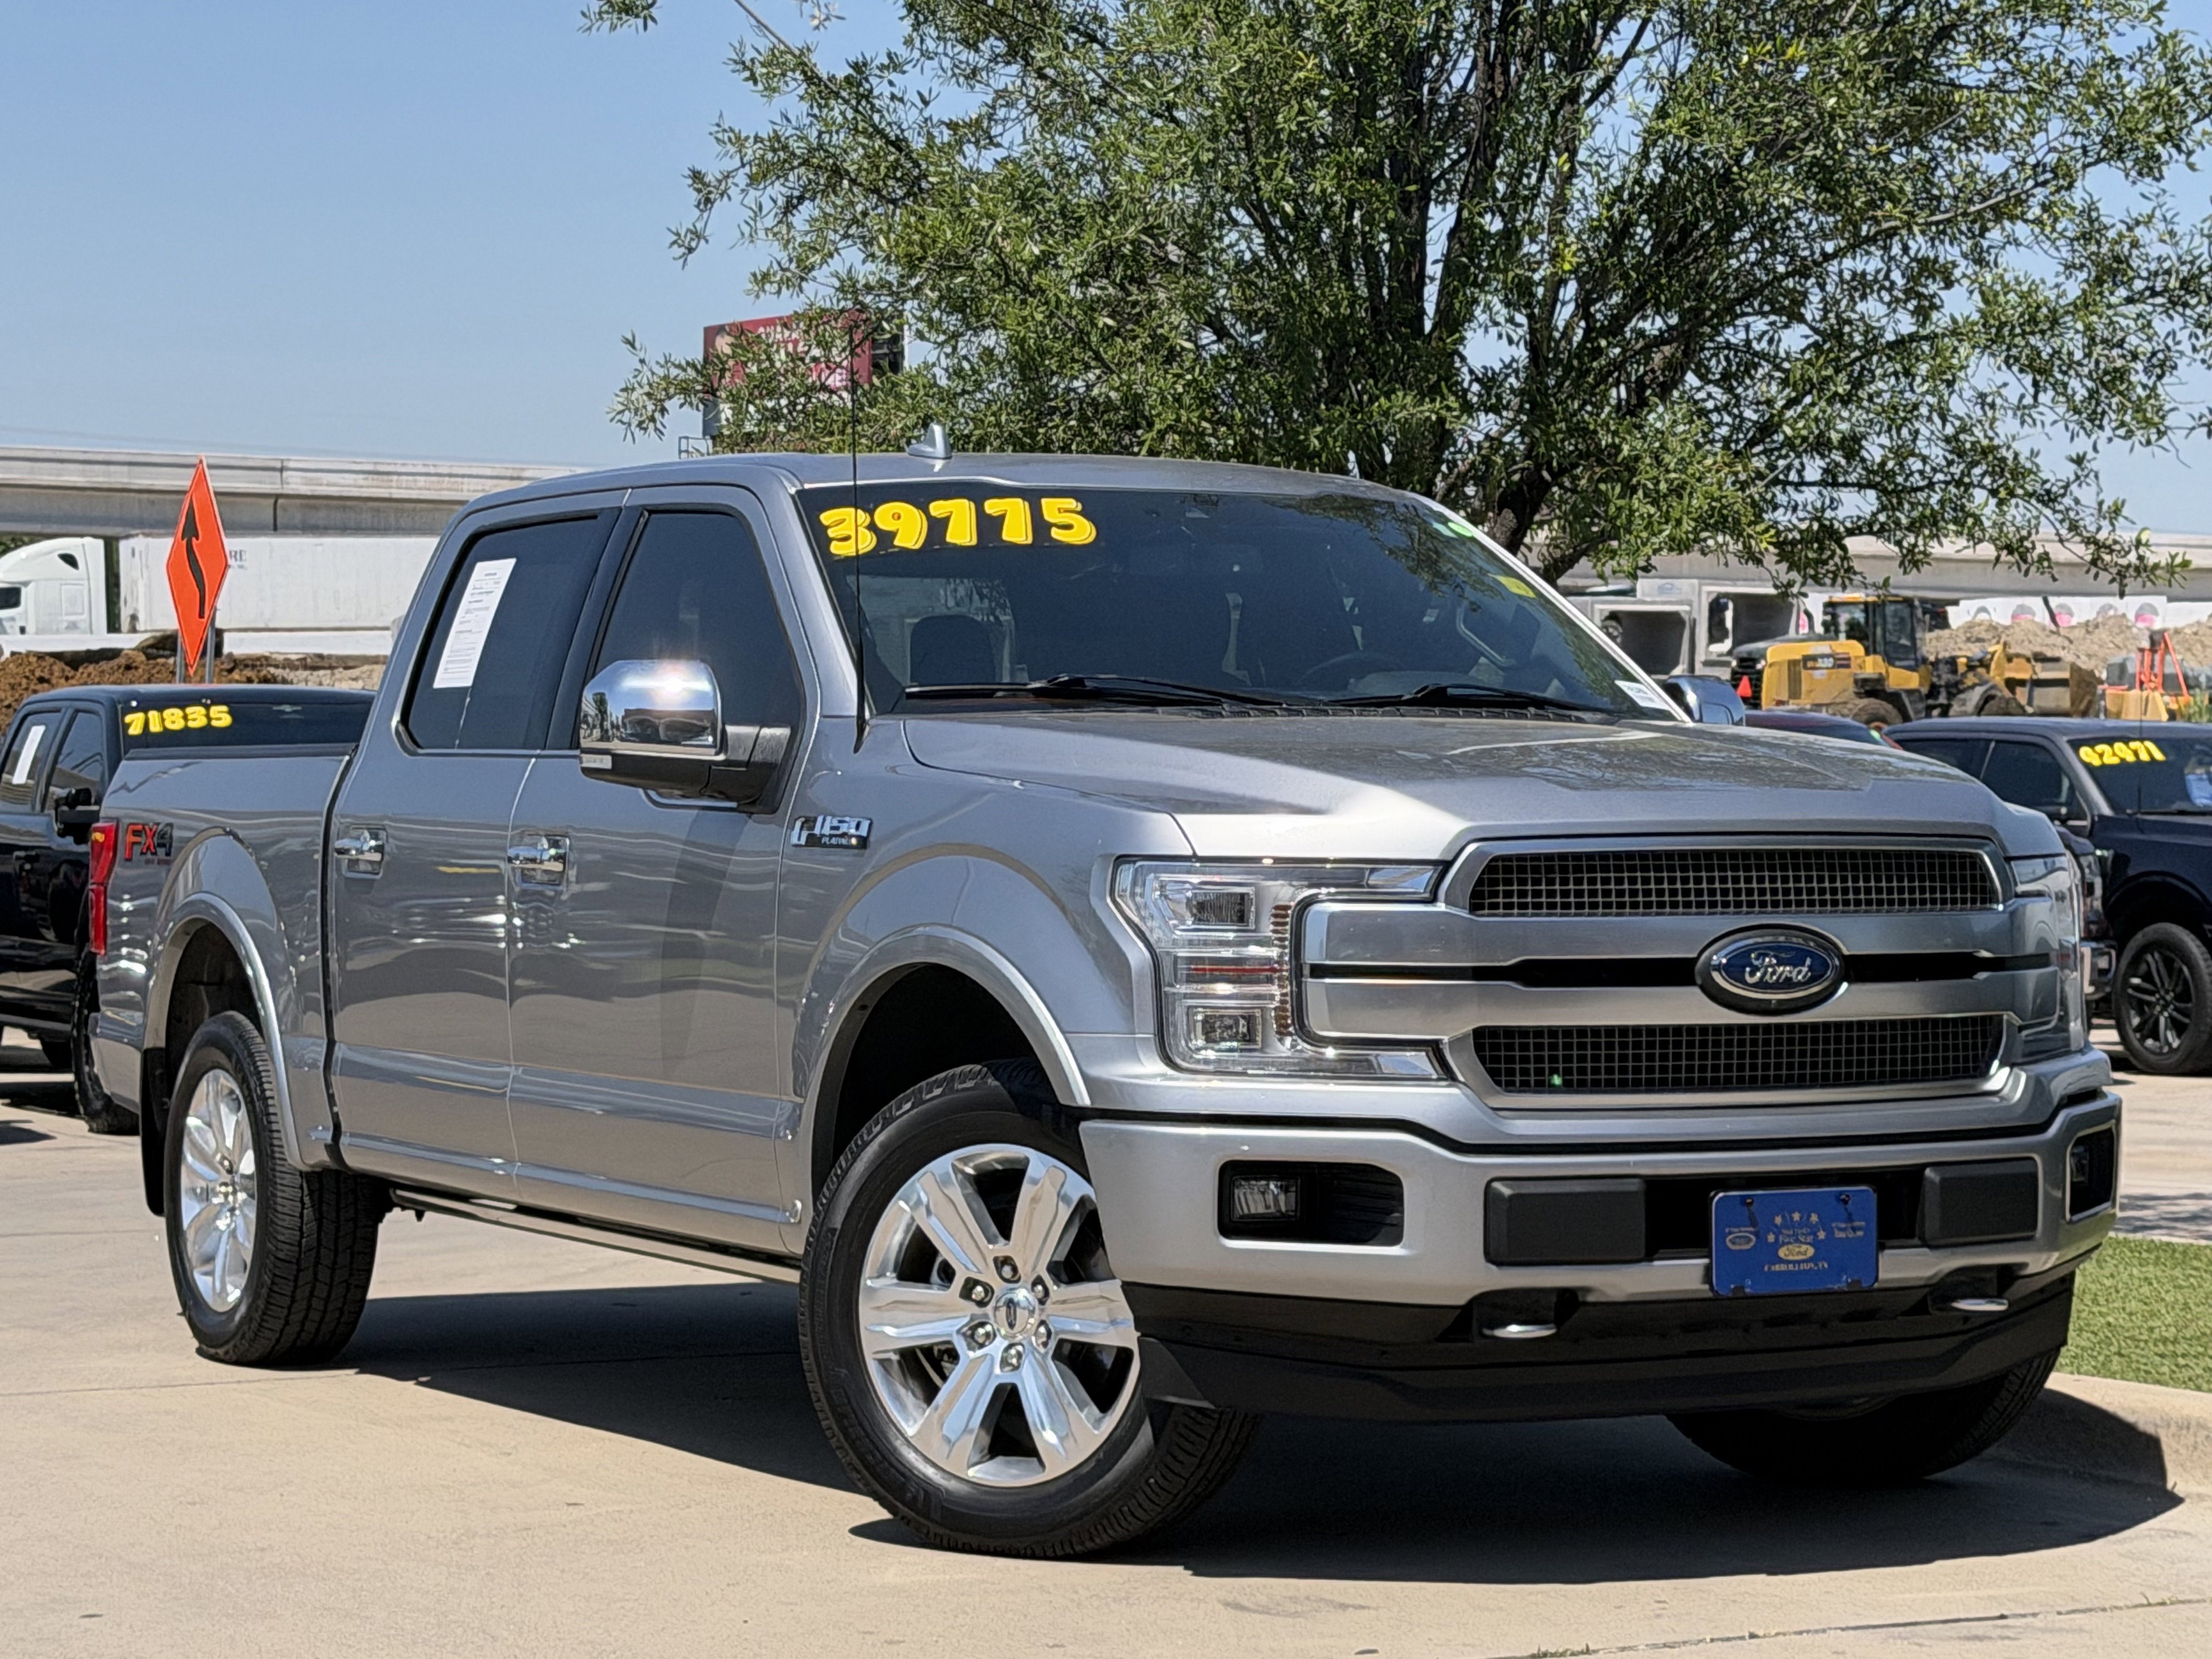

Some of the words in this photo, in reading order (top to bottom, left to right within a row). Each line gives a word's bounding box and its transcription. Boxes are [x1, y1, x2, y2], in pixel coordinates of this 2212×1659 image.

[819, 498, 1097, 556] 39775
[124, 705, 233, 736] 71835
[124, 822, 174, 861] FX4
[1745, 949, 1812, 984] Ford
